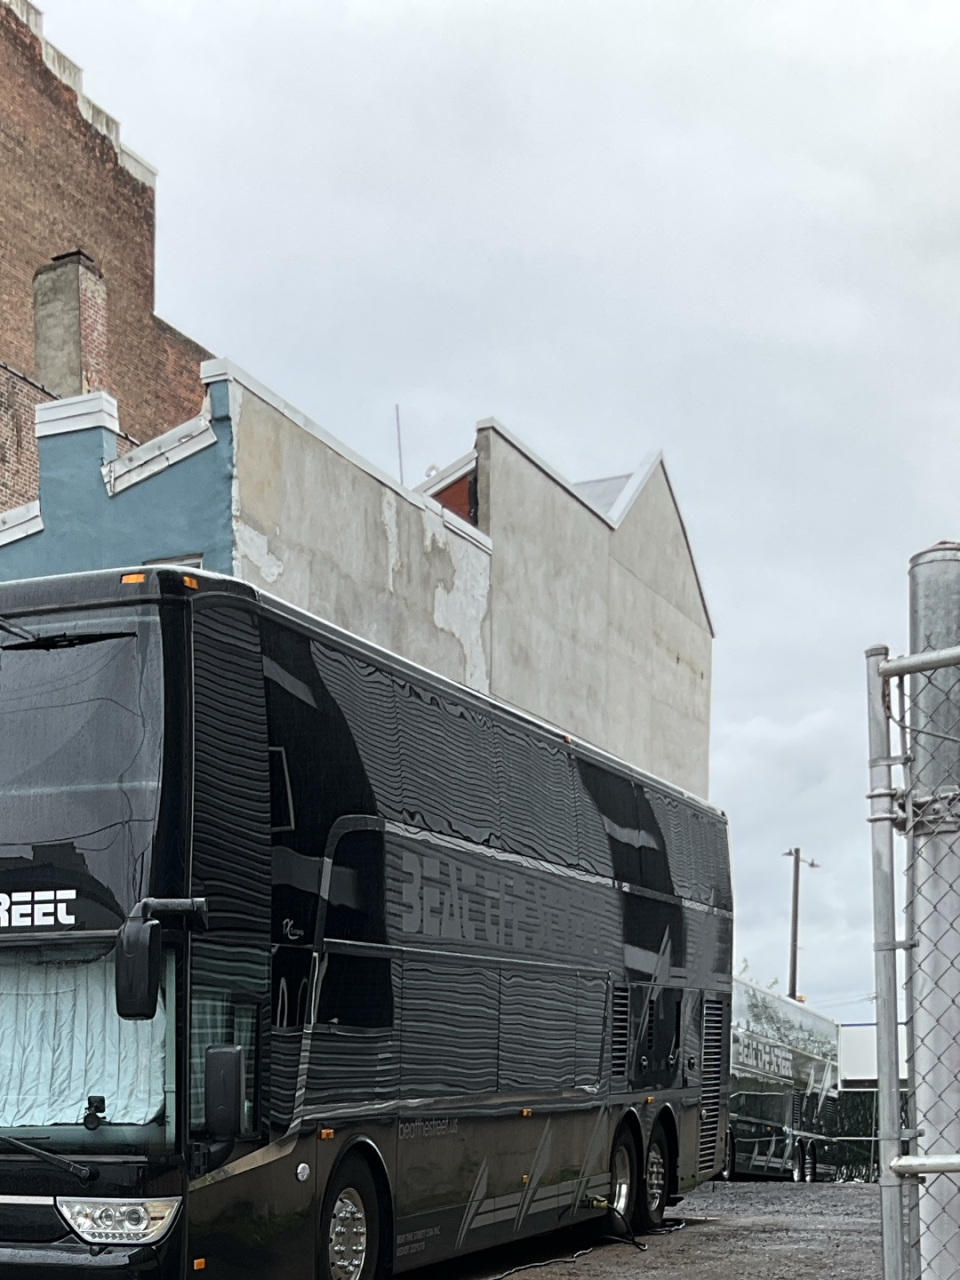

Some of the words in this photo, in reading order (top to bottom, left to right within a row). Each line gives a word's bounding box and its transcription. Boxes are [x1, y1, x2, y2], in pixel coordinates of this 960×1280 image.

[402, 852, 477, 941] BEAT
[738, 1036, 757, 1067] BEAT
[757, 1042, 770, 1070] THE
[770, 1046, 793, 1078] STREET
